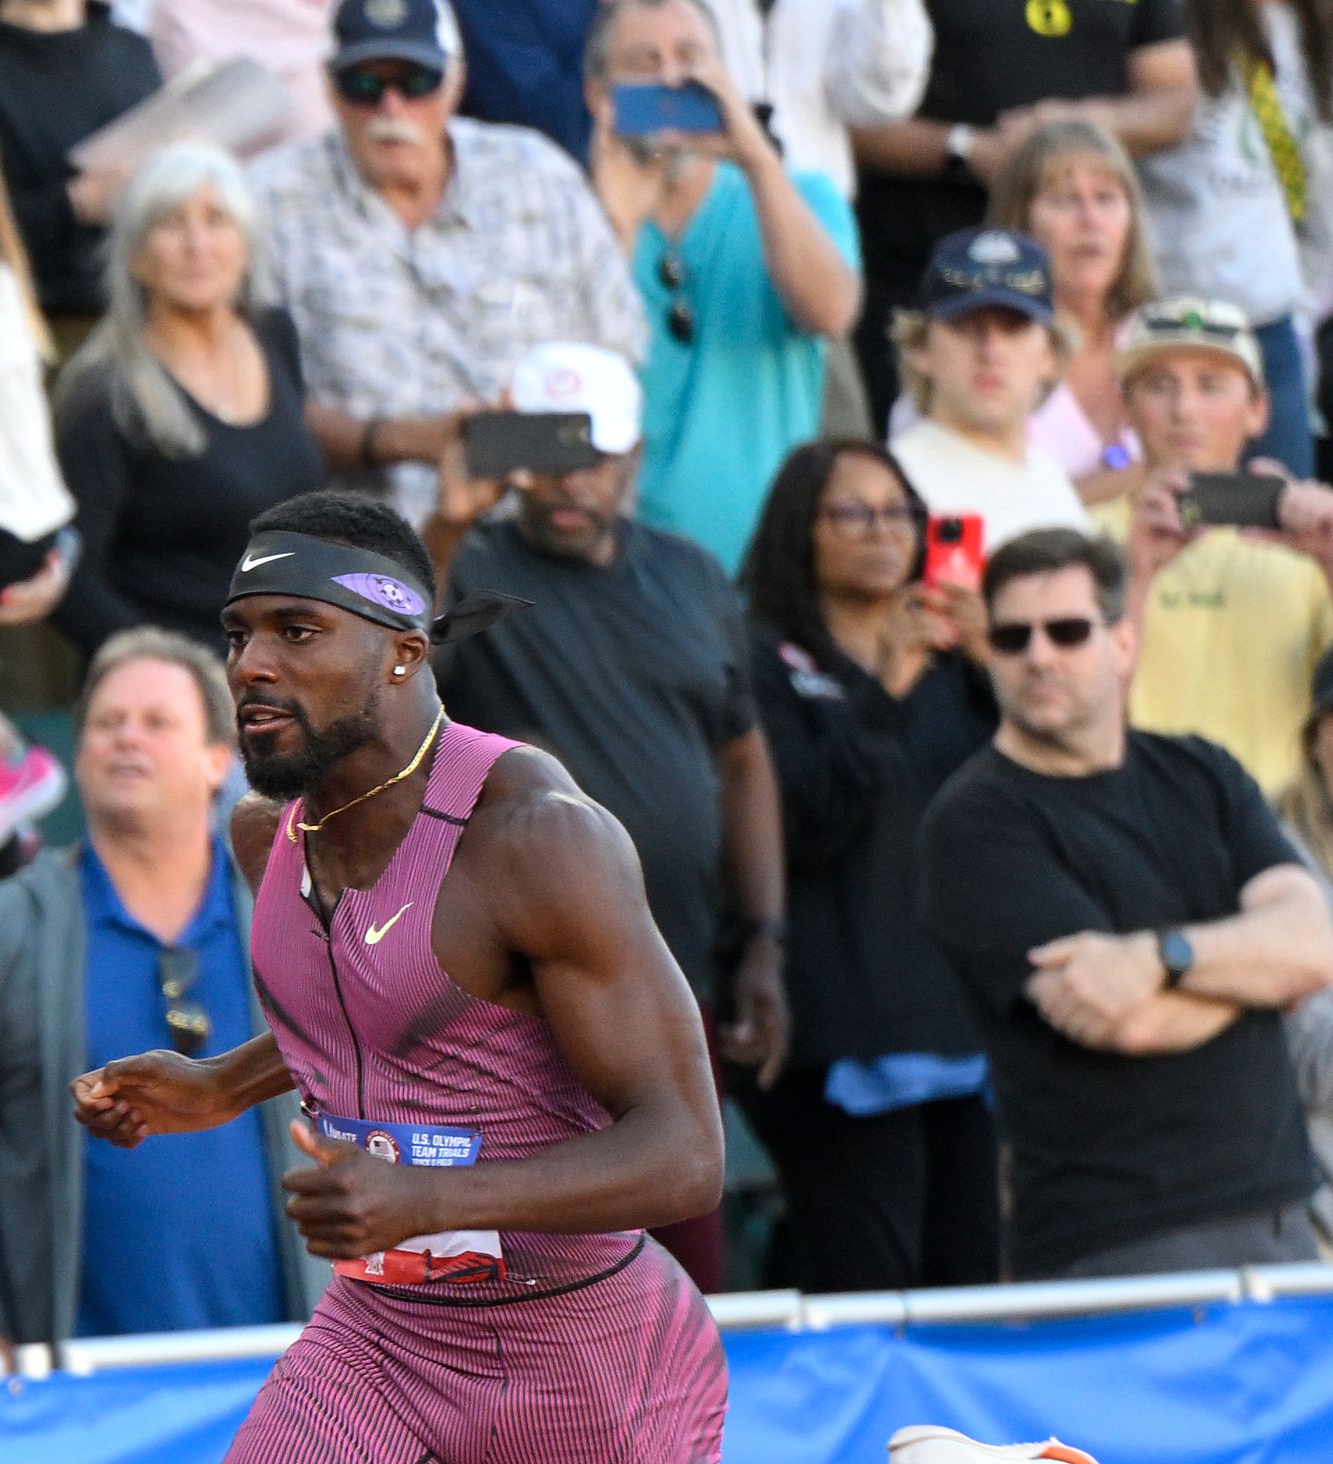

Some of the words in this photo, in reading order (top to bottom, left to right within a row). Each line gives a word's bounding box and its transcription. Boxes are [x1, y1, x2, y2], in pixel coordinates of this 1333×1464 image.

[412, 1132, 430, 1146] U.S.
[433, 1134, 472, 1148] OLYMPIC
[411, 1145, 437, 1158] TEAM
[438, 1147, 470, 1158] TRIALS
